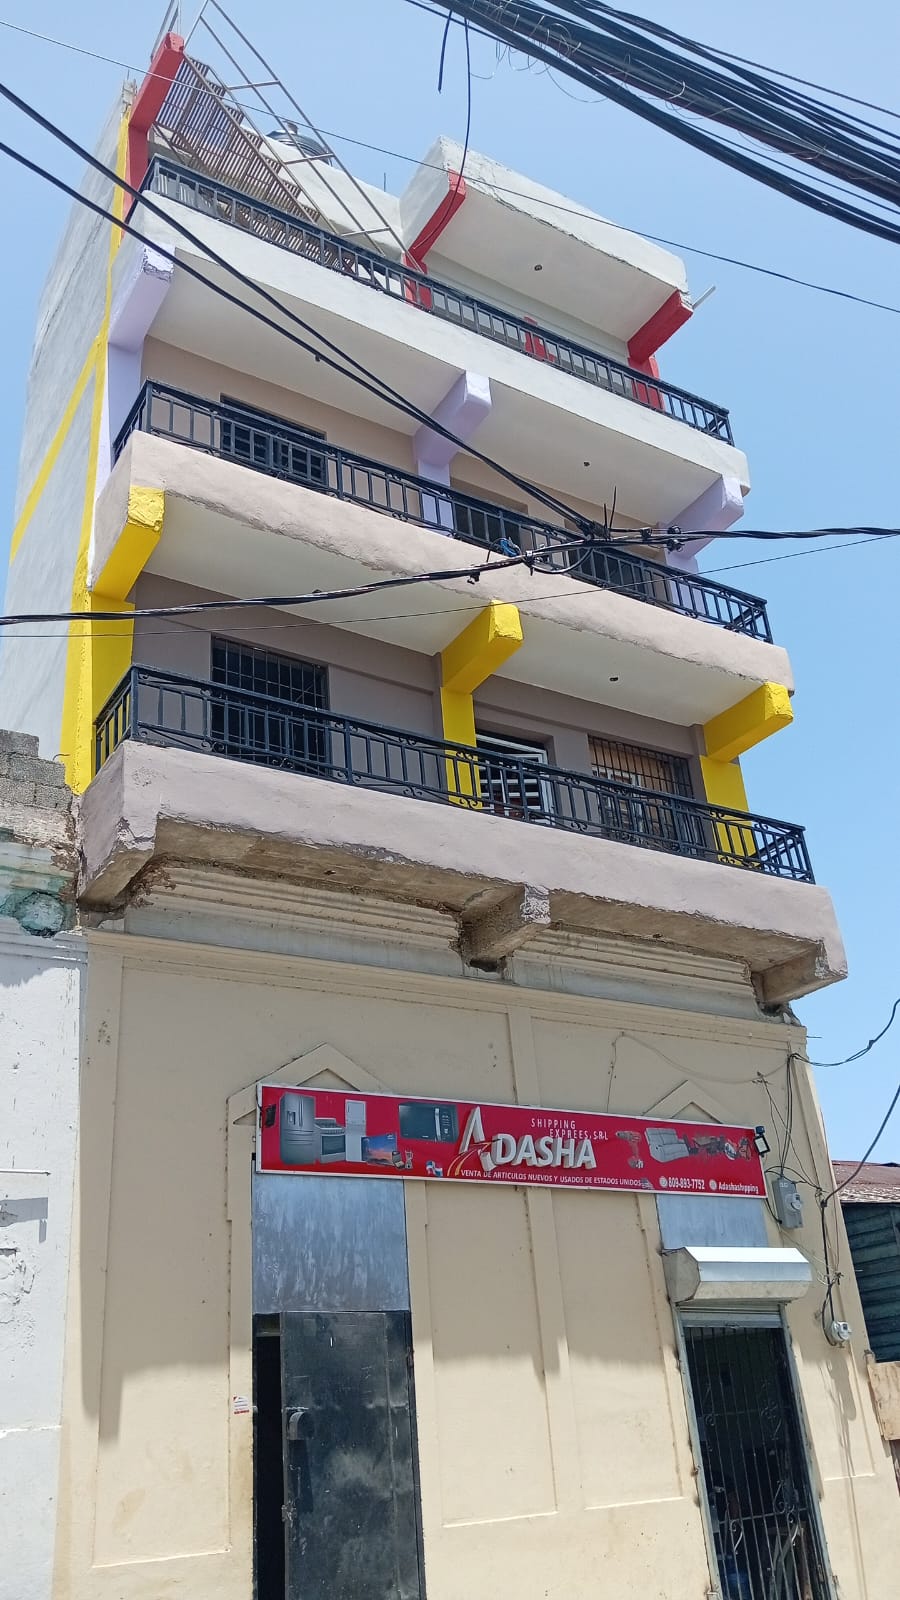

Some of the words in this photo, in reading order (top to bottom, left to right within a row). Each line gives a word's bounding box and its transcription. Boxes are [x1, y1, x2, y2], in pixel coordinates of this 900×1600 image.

[531, 1118, 576, 1129] SHIPPING
[458, 1106, 597, 1172] ADASHA
[461, 1169, 482, 1178] VENTA
[483, 1170, 492, 1179] DE
[492, 1171, 527, 1181] ARTICULOS
[528, 1173, 553, 1183] NUEVOS
[553, 1175, 559, 1183] Y
[560, 1175, 584, 1184] USADOS
[584, 1176, 593, 1185] DE
[593, 1177, 619, 1186] ESTADOS
[619, 1178, 642, 1187] UNIDOS
[718, 1181, 759, 1194] Adashashipping
